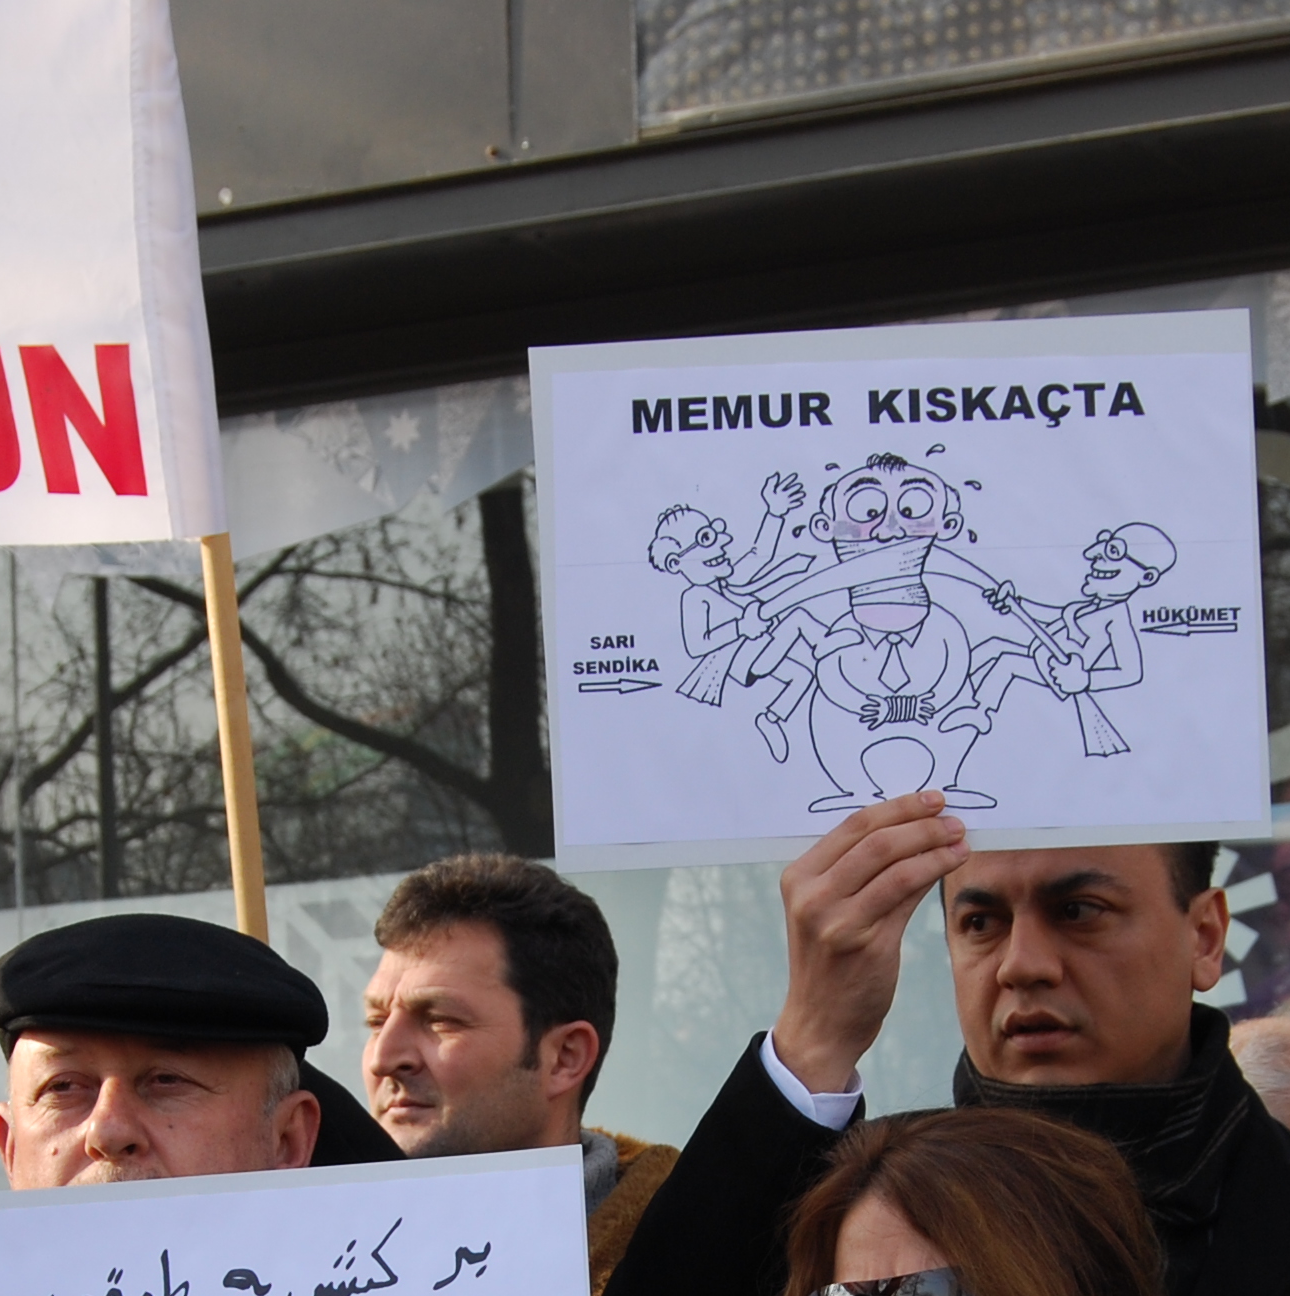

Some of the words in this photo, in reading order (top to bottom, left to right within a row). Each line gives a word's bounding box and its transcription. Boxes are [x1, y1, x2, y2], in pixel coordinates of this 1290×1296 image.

[631, 391, 833, 434] MEMUR
[867, 381, 1146, 428] KISKAÇTA
[1141, 606, 1242, 626] HÜKÜMET
[590, 634, 636, 651] SARI
[572, 656, 661, 676] SENDİKA
